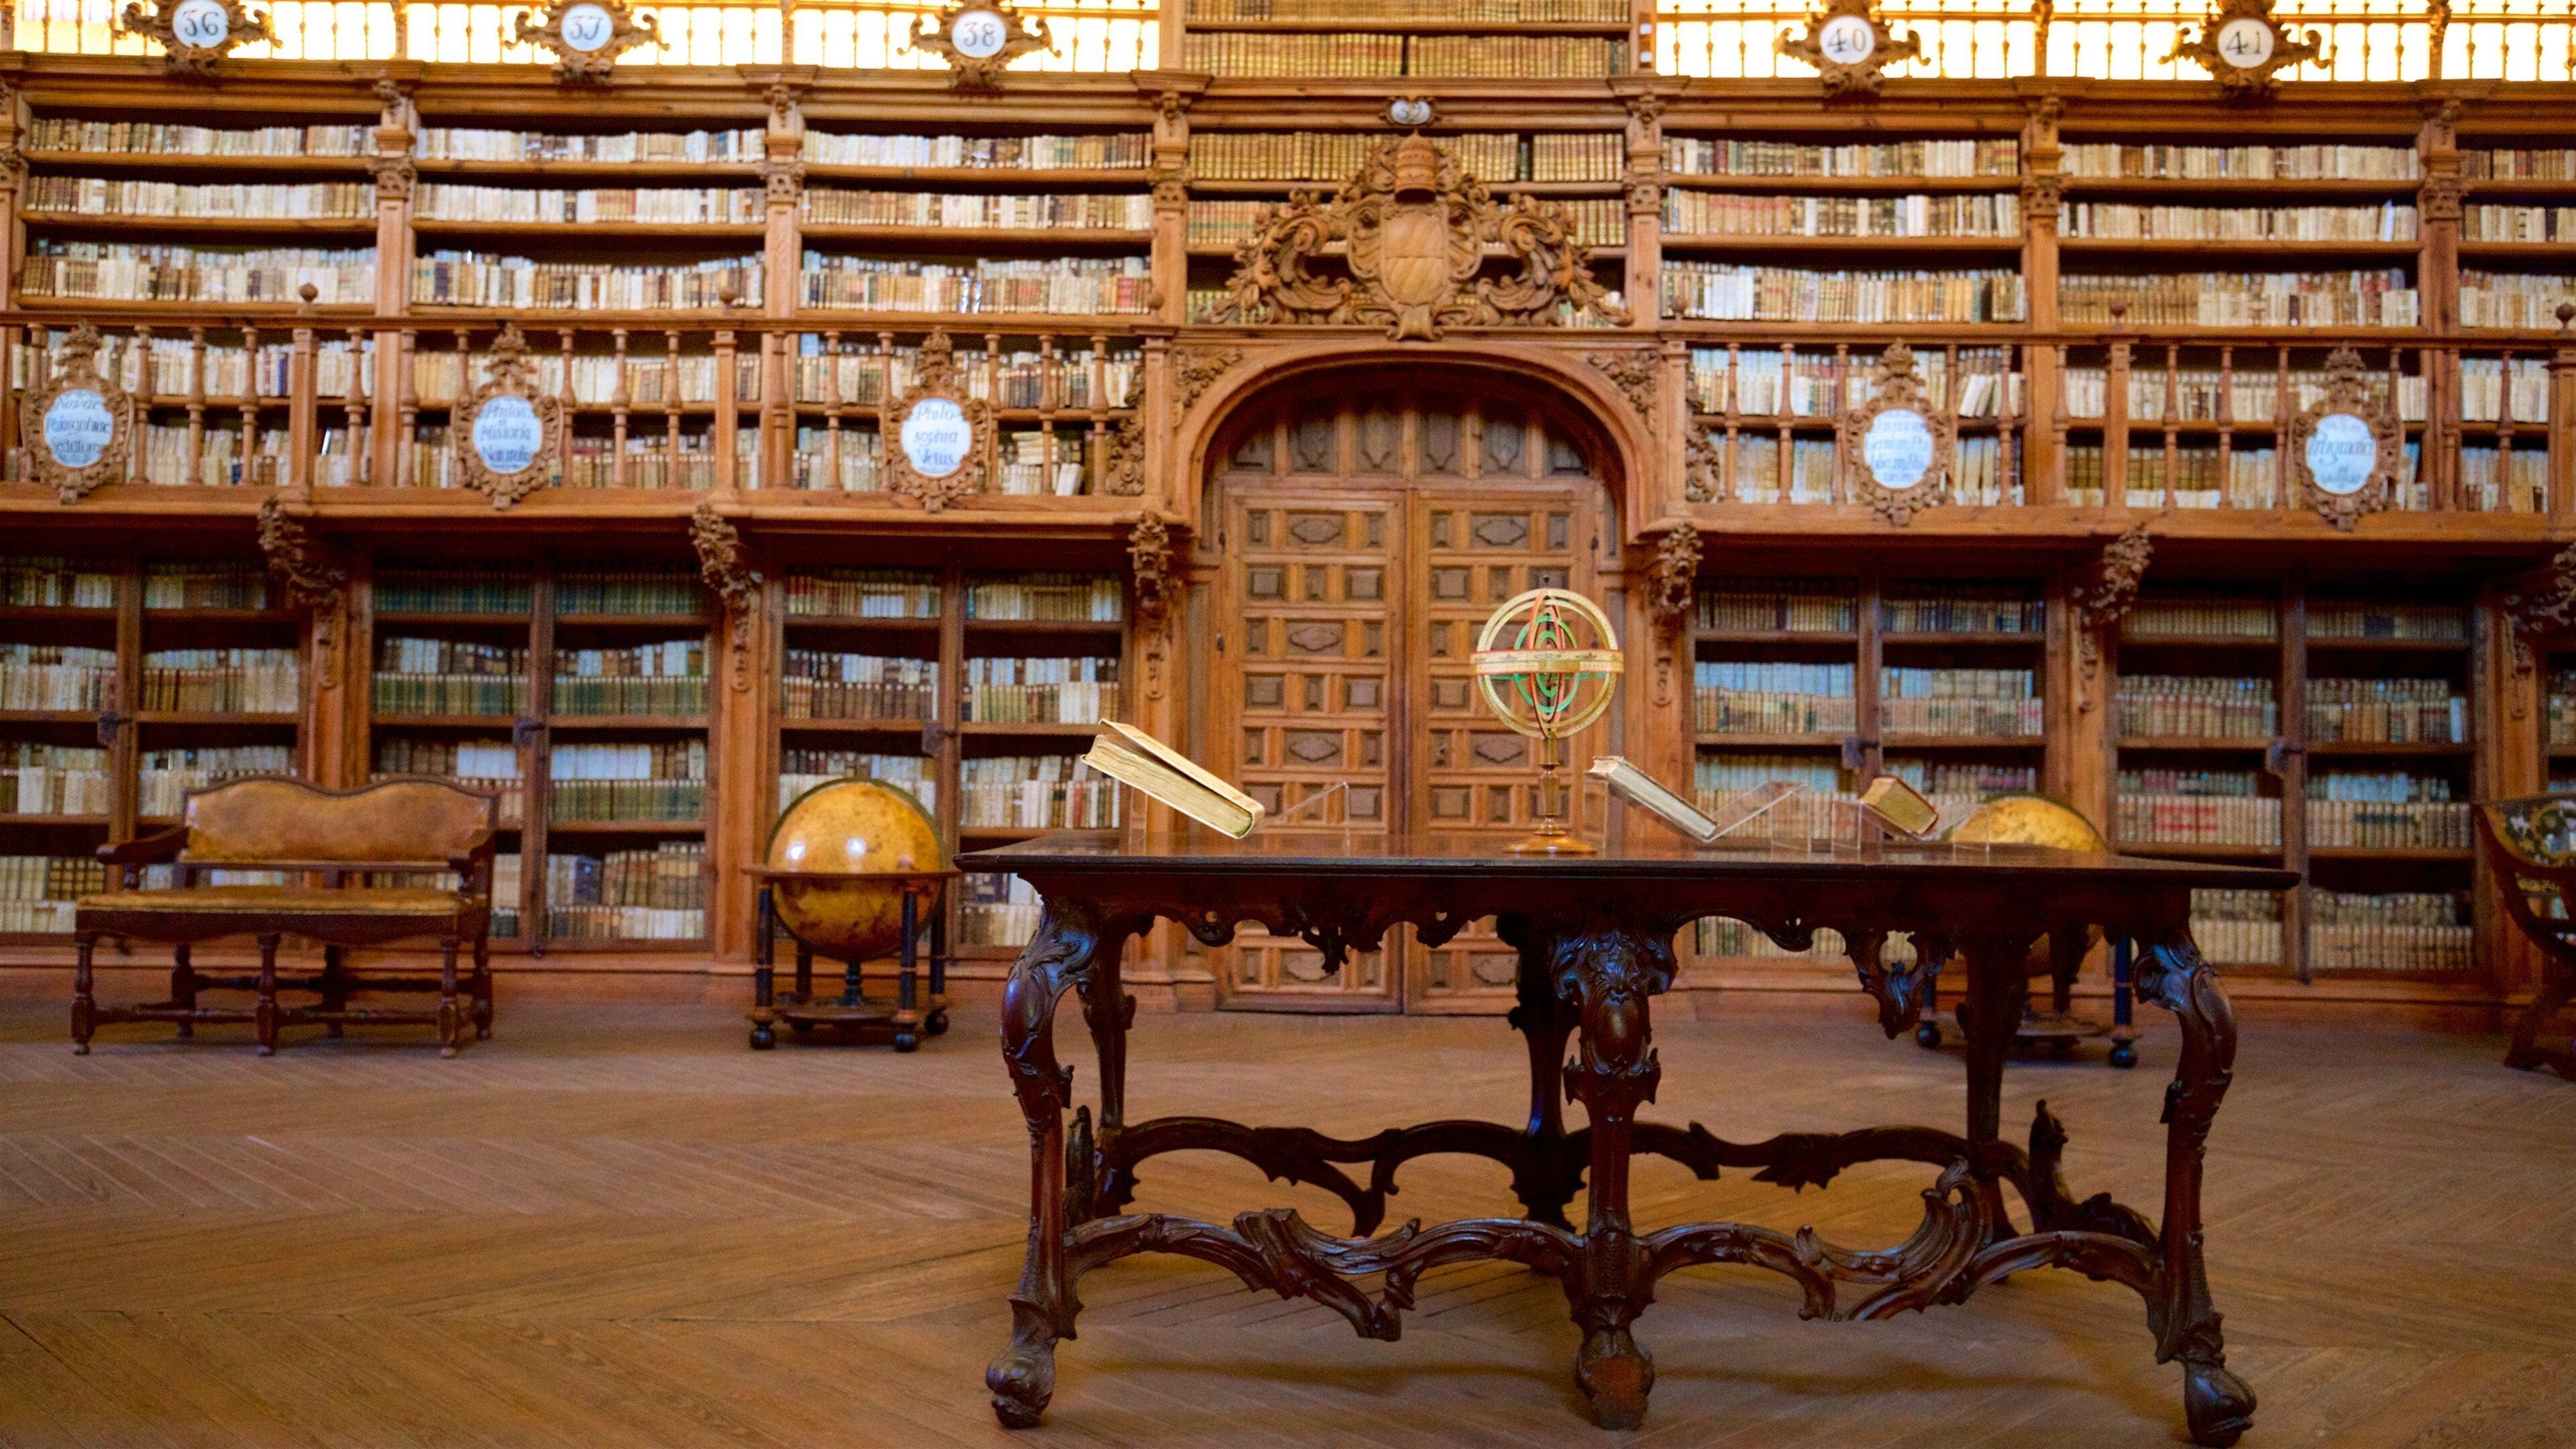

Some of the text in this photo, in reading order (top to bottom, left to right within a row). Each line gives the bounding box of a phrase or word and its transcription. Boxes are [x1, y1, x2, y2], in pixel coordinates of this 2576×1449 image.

[183, 10, 219, 37] 36
[963, 21, 995, 47] 38
[1828, 28, 1866, 52] 40
[2226, 30, 2261, 54] 41
